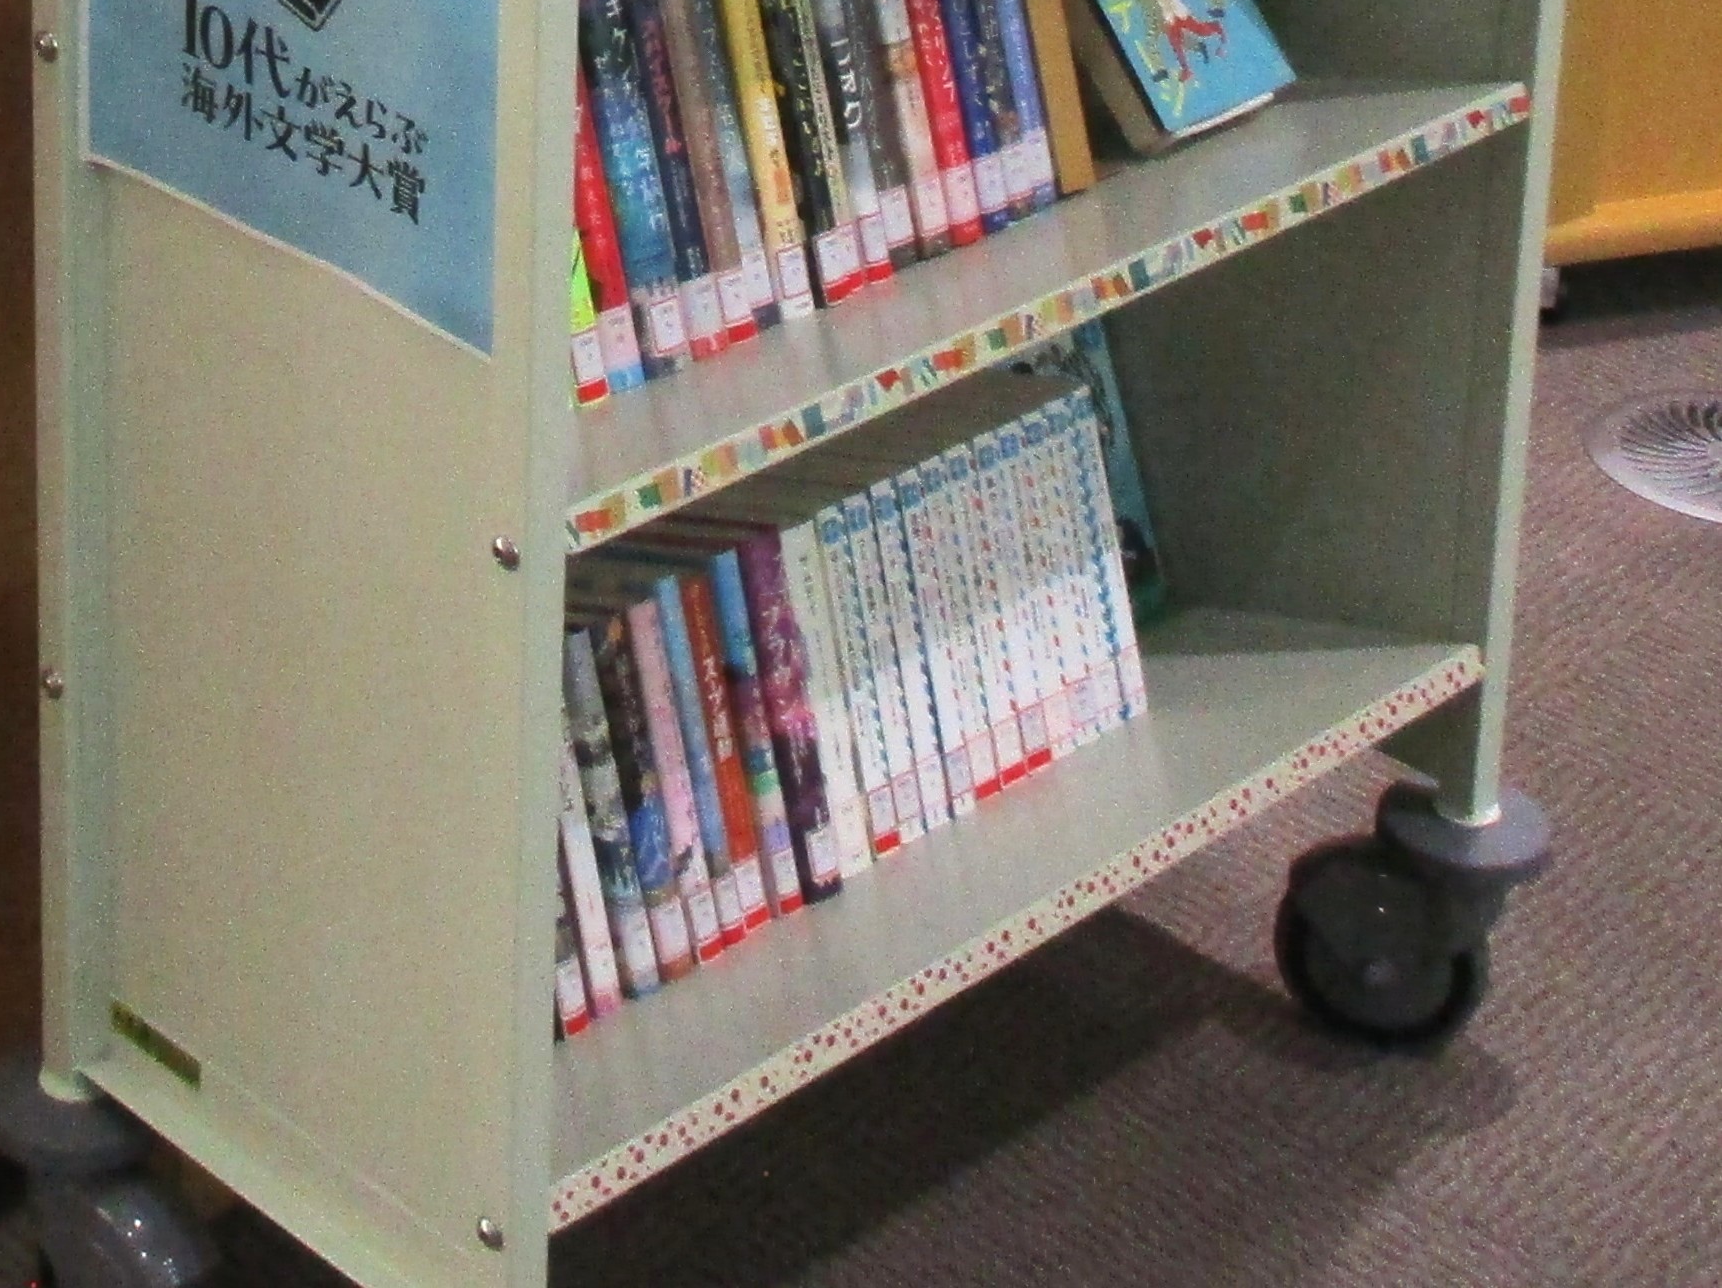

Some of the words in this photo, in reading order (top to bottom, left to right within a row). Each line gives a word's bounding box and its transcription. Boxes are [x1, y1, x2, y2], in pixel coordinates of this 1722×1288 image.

[181, 62, 427, 225] 海外文学大賞
